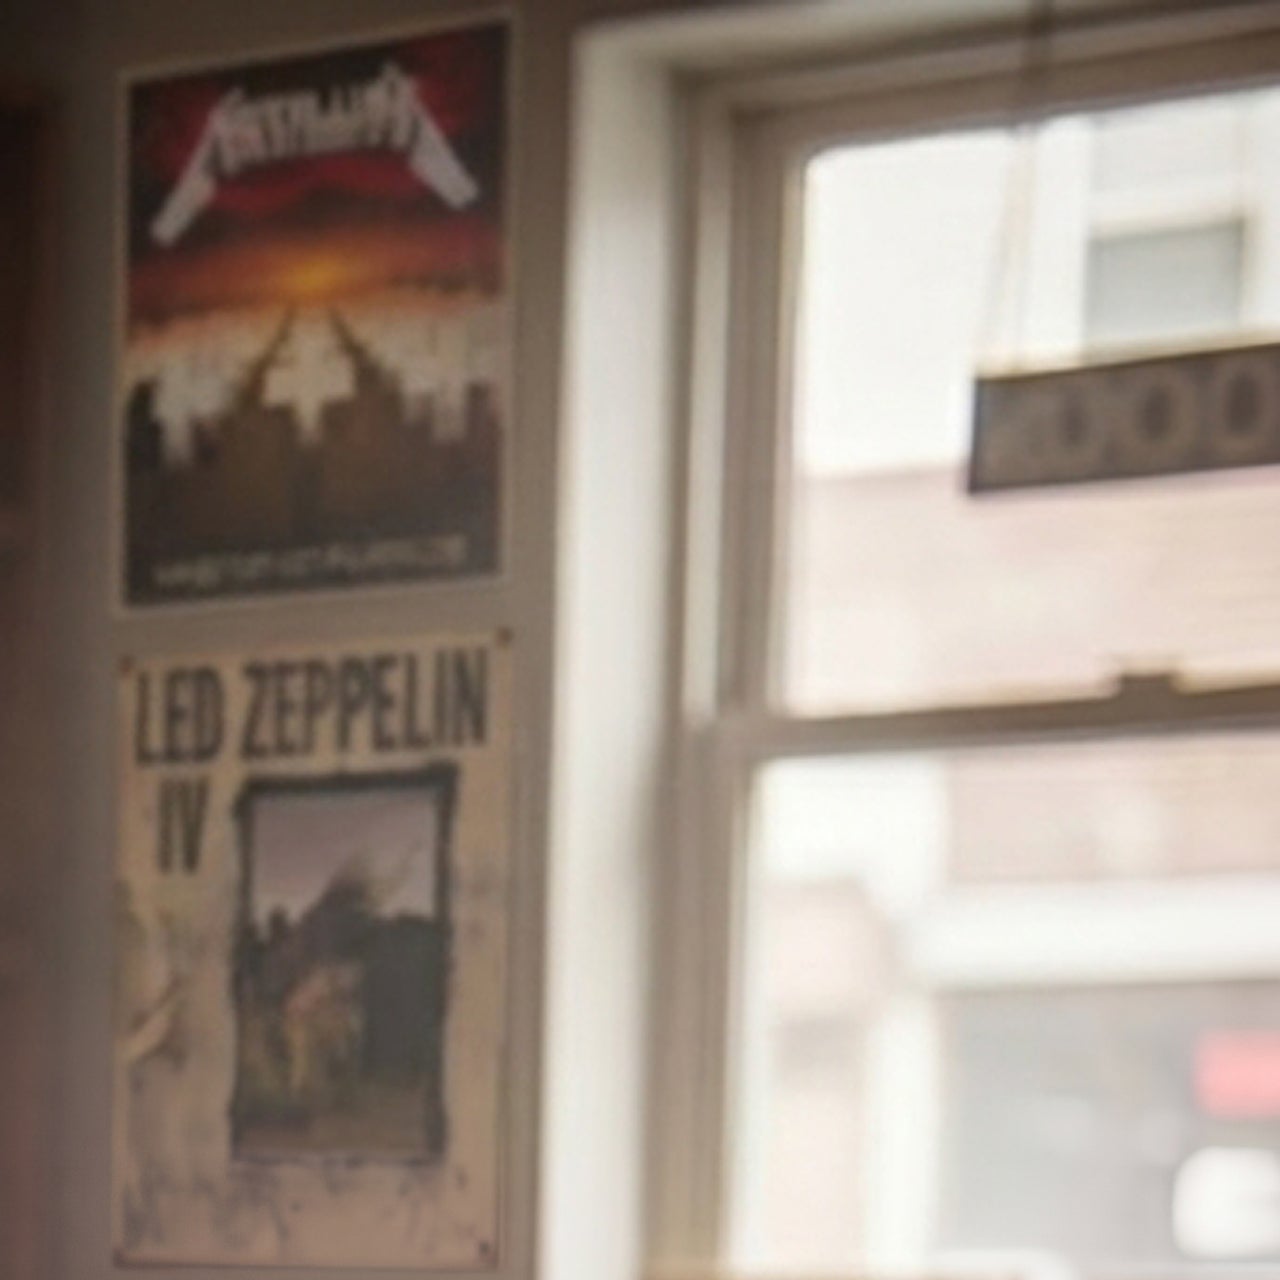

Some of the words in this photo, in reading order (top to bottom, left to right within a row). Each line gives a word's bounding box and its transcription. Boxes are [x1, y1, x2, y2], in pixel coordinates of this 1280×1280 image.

[136, 667, 225, 767] LED
[241, 648, 489, 760] ZEPPELIN
[156, 777, 209, 875] IV
